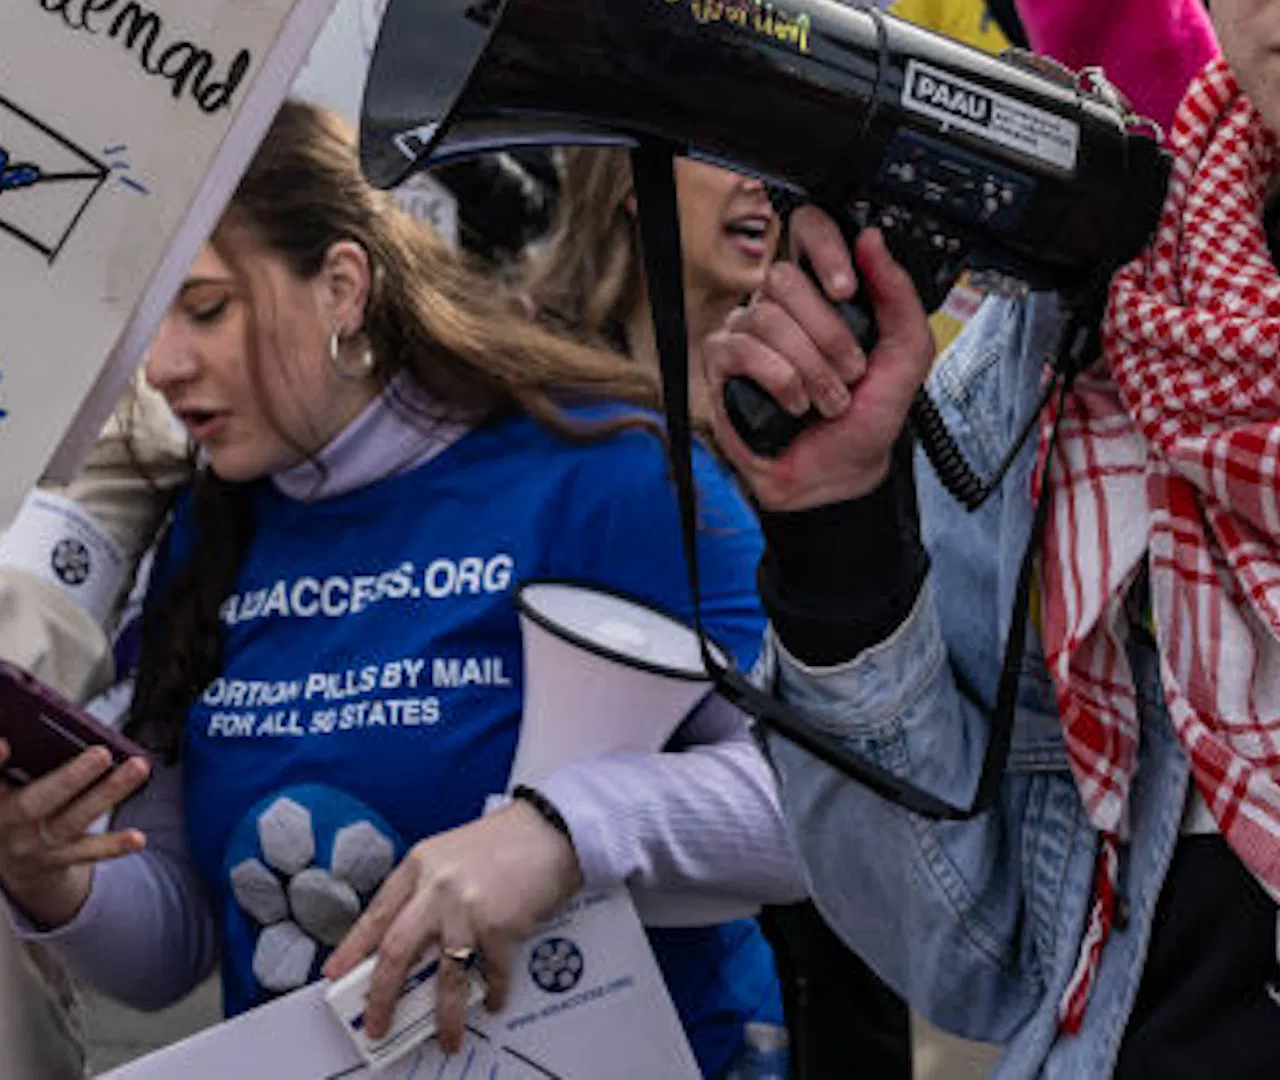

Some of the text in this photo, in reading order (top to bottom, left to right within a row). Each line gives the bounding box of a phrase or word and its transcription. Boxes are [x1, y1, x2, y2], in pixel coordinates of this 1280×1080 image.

[915, 74, 988, 121] PAAU
[202, 655, 514, 708] ORTION PILLS BY MAIL
[207, 710, 258, 739] FOR
[256, 709, 306, 738] ALL
[337, 695, 441, 732] STATES
